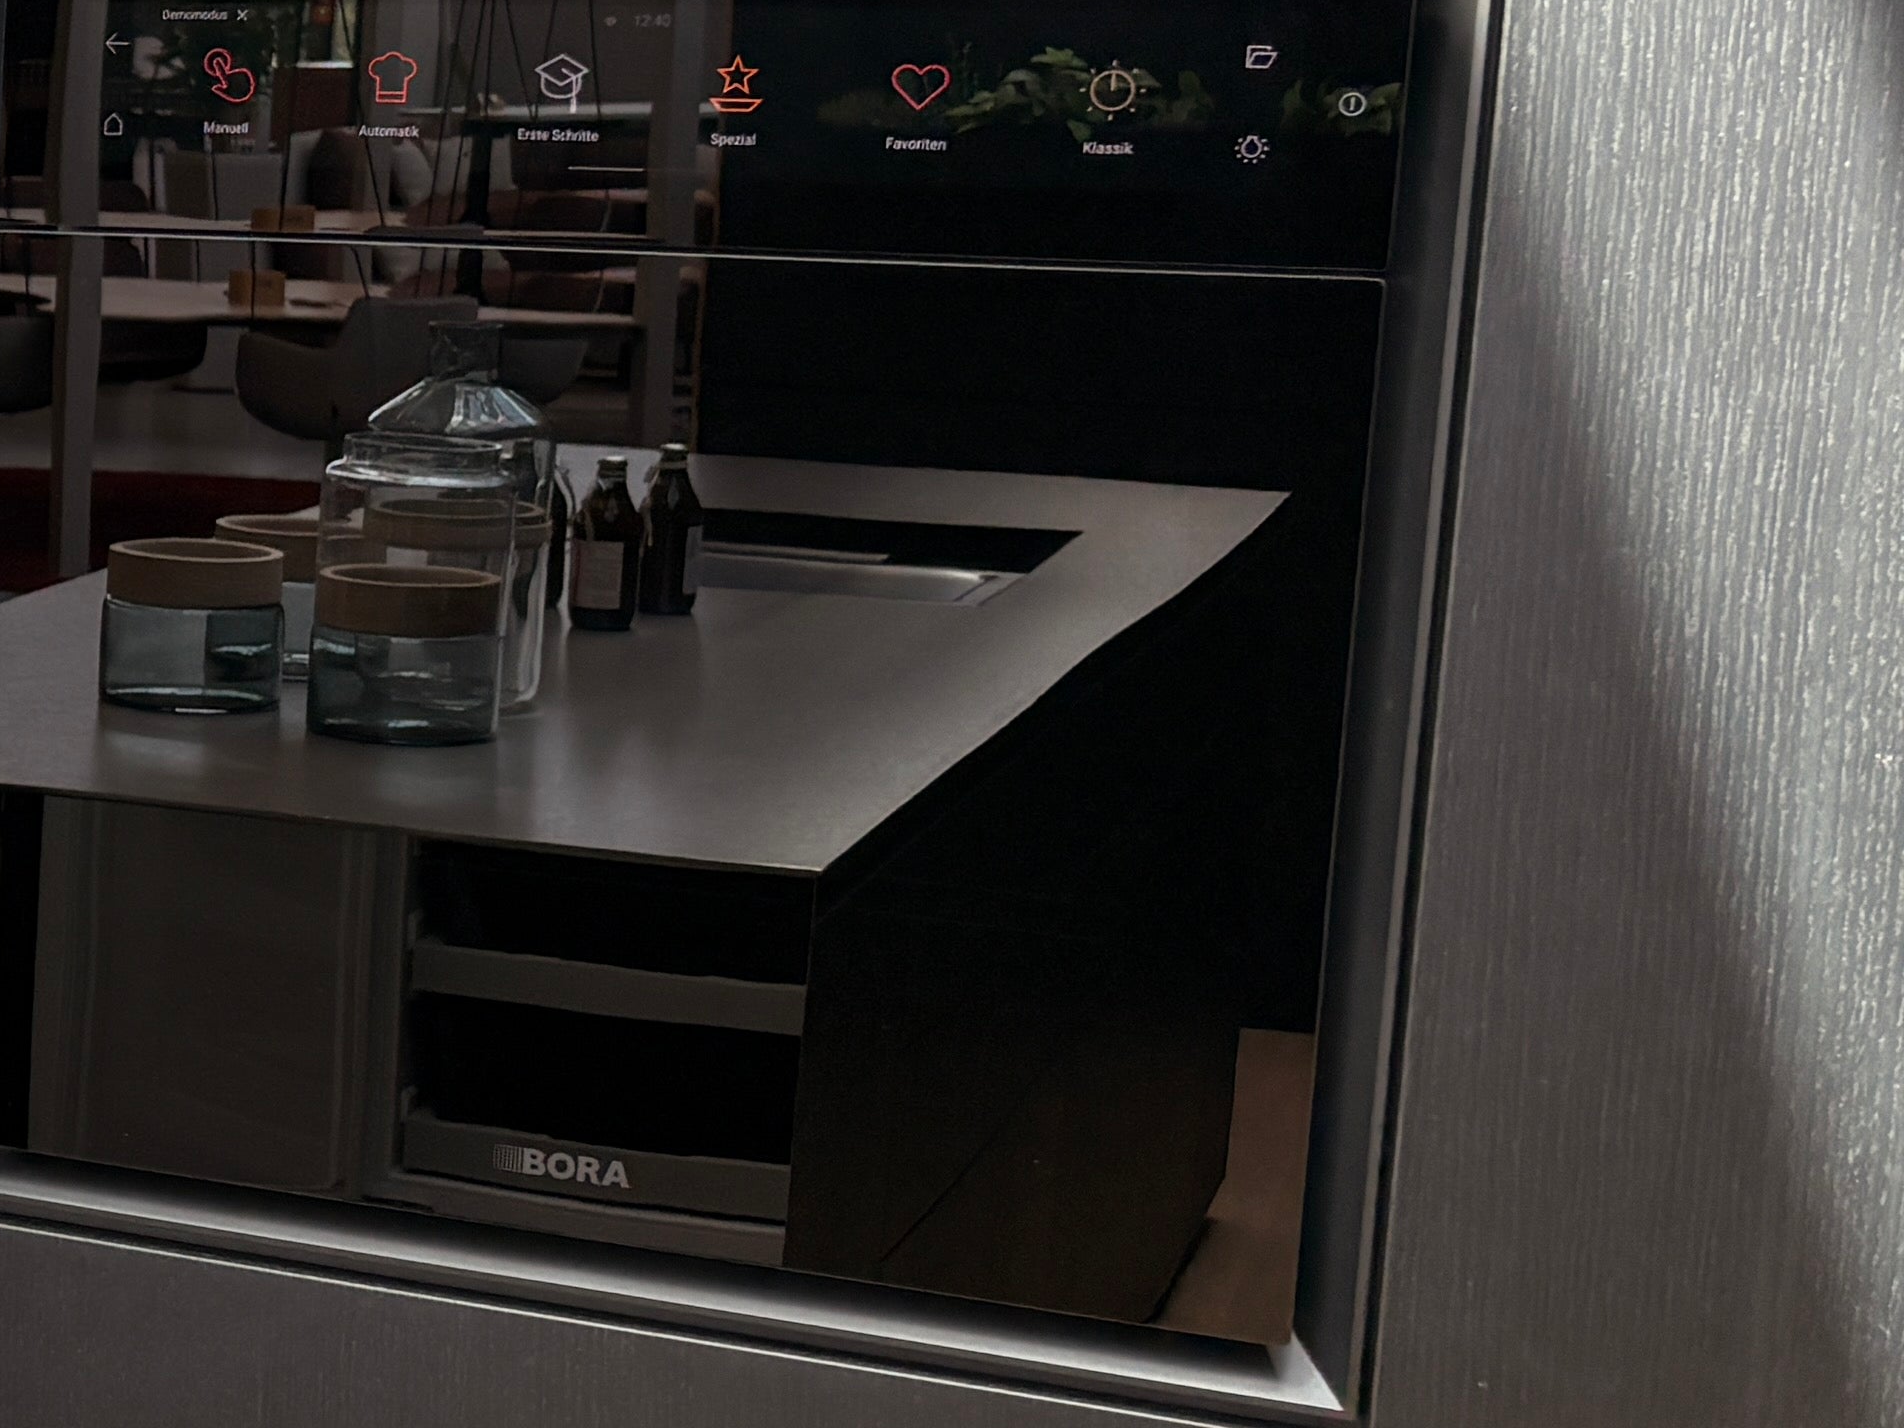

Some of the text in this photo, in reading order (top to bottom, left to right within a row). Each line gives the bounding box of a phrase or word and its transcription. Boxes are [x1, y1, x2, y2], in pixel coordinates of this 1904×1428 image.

[203, 121, 250, 134] Manuell
[358, 124, 420, 139] Automatik
[517, 127, 600, 143] Erste Schritte
[710, 132, 757, 147] Spezial
[885, 136, 948, 152] Favoriten
[1082, 141, 1135, 156] Klassik
[522, 1147, 632, 1188] BORA
